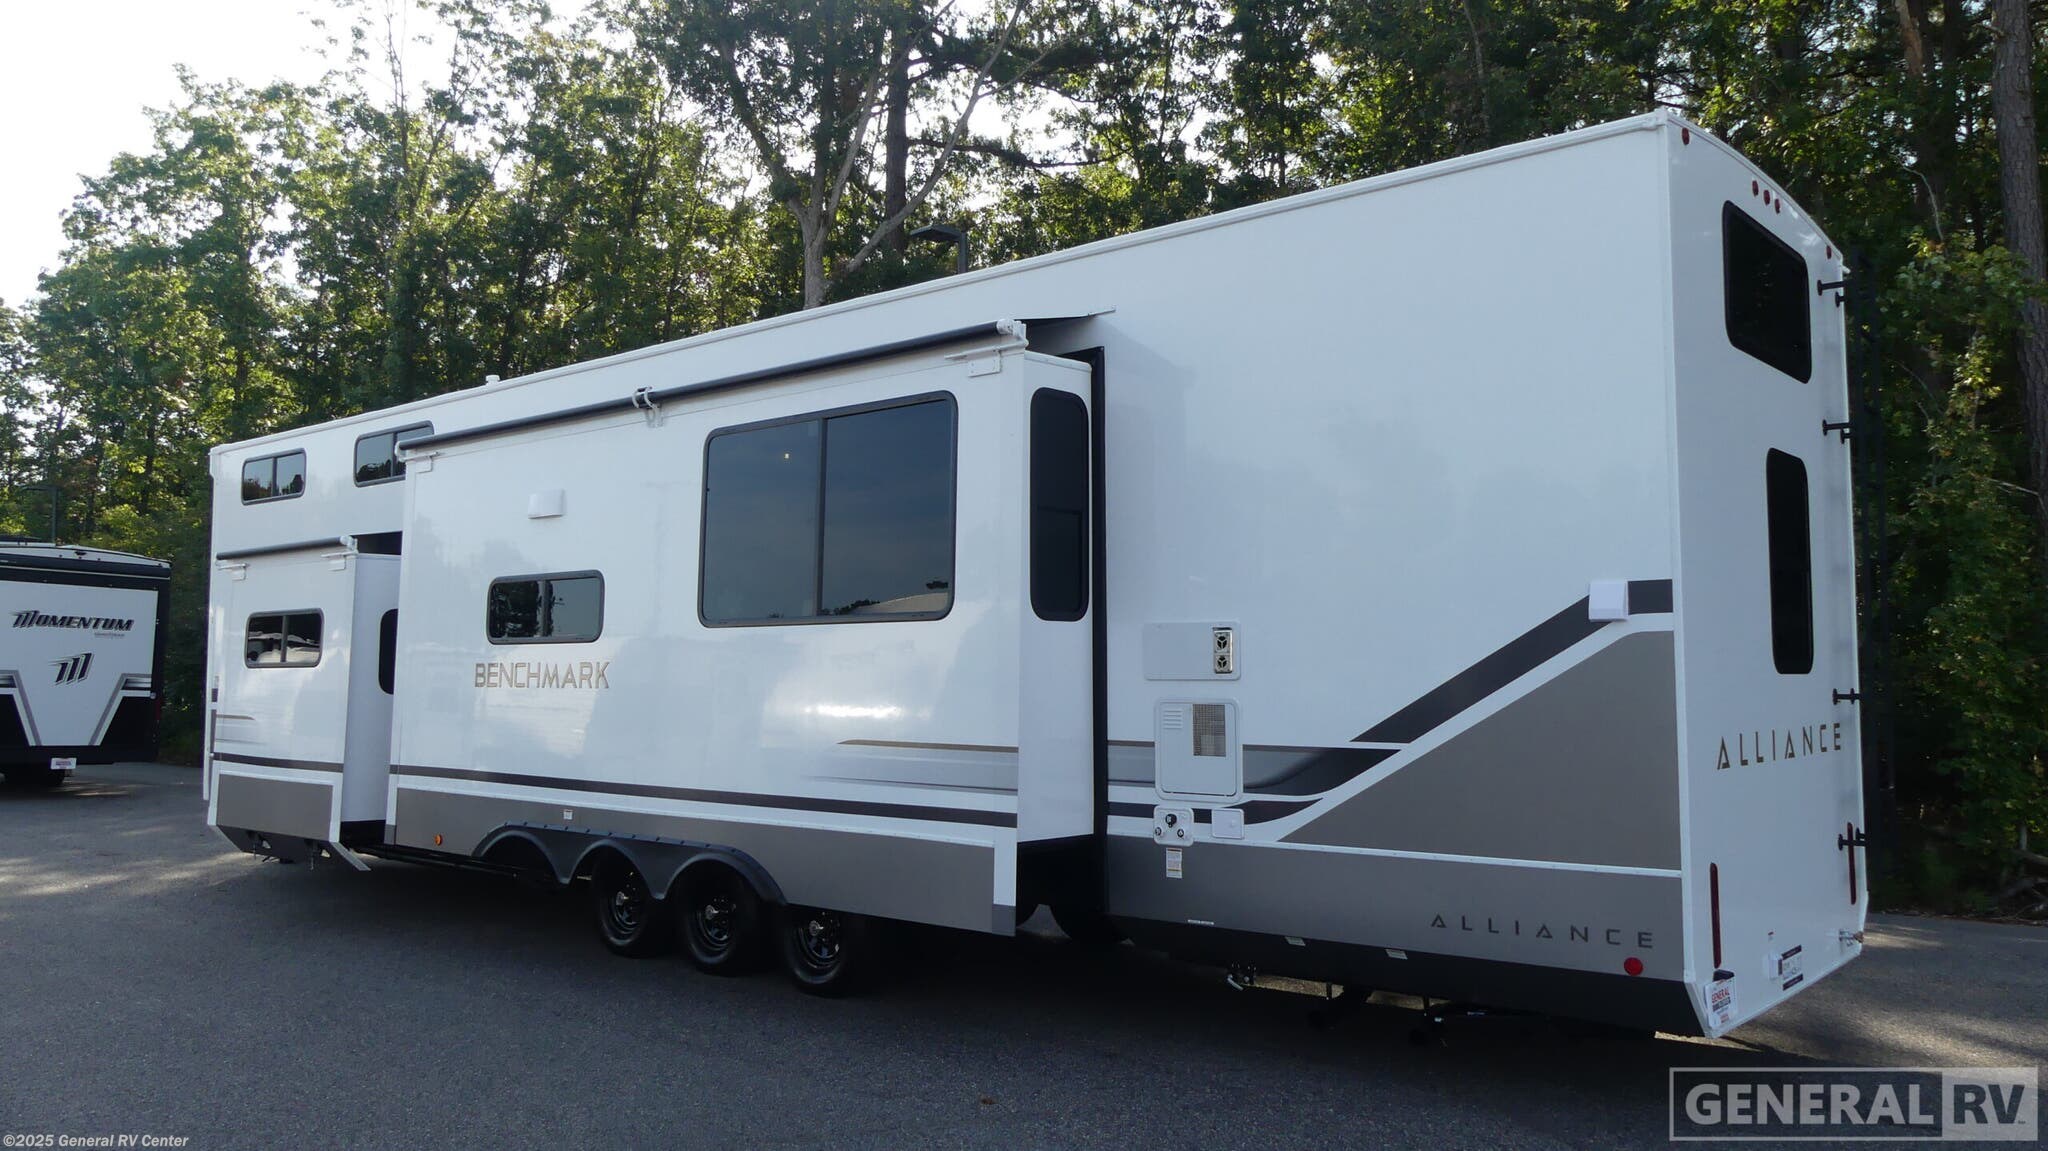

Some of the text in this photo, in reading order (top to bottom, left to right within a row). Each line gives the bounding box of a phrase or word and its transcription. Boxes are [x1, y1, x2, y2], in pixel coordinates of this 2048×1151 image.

[12, 610, 134, 631] MOMENTUM
[474, 661, 610, 689] BENCHMARK
[1716, 722, 1841, 770] ALLIANCE
[1430, 913, 1654, 949] ALLIANCE
